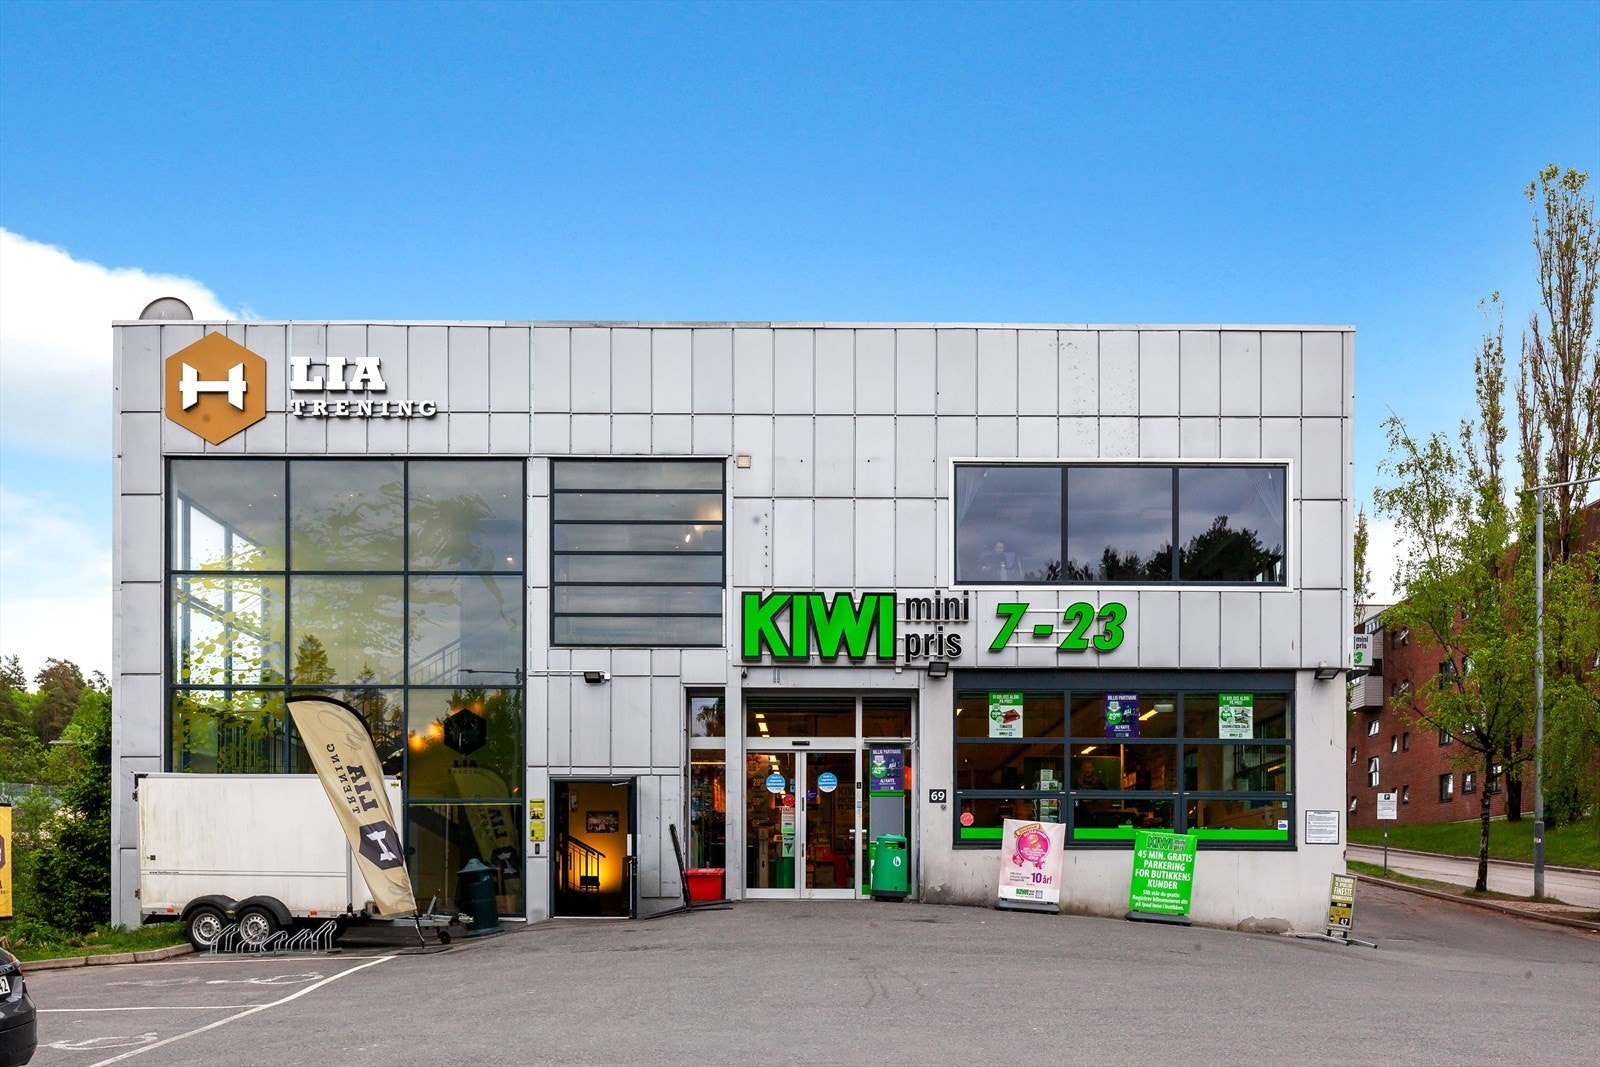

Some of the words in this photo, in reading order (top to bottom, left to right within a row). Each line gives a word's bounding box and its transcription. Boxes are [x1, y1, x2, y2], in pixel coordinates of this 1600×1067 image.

[290, 356, 386, 392] LIA
[290, 399, 437, 417] TRENING
[905, 589, 969, 621] mini
[741, 591, 897, 662] KIWI
[904, 625, 963, 663] pris
[930, 791, 945, 801] 69
[1146, 836, 1174, 850] KIWI
[1137, 850, 1147, 858] 45
[1148, 851, 1166, 860] MIN.
[1167, 852, 1193, 862] GRATIS
[1143, 860, 1185, 871] PARKERING
[1031, 872, 1042, 884] 10
[1042, 874, 1052, 885] år!
[1135, 868, 1150, 878] FOR
[1151, 870, 1191, 881] BUTIKKENS
[1147, 880, 1178, 890] KUNDER
[1333, 886, 1353, 897] FINESTE
